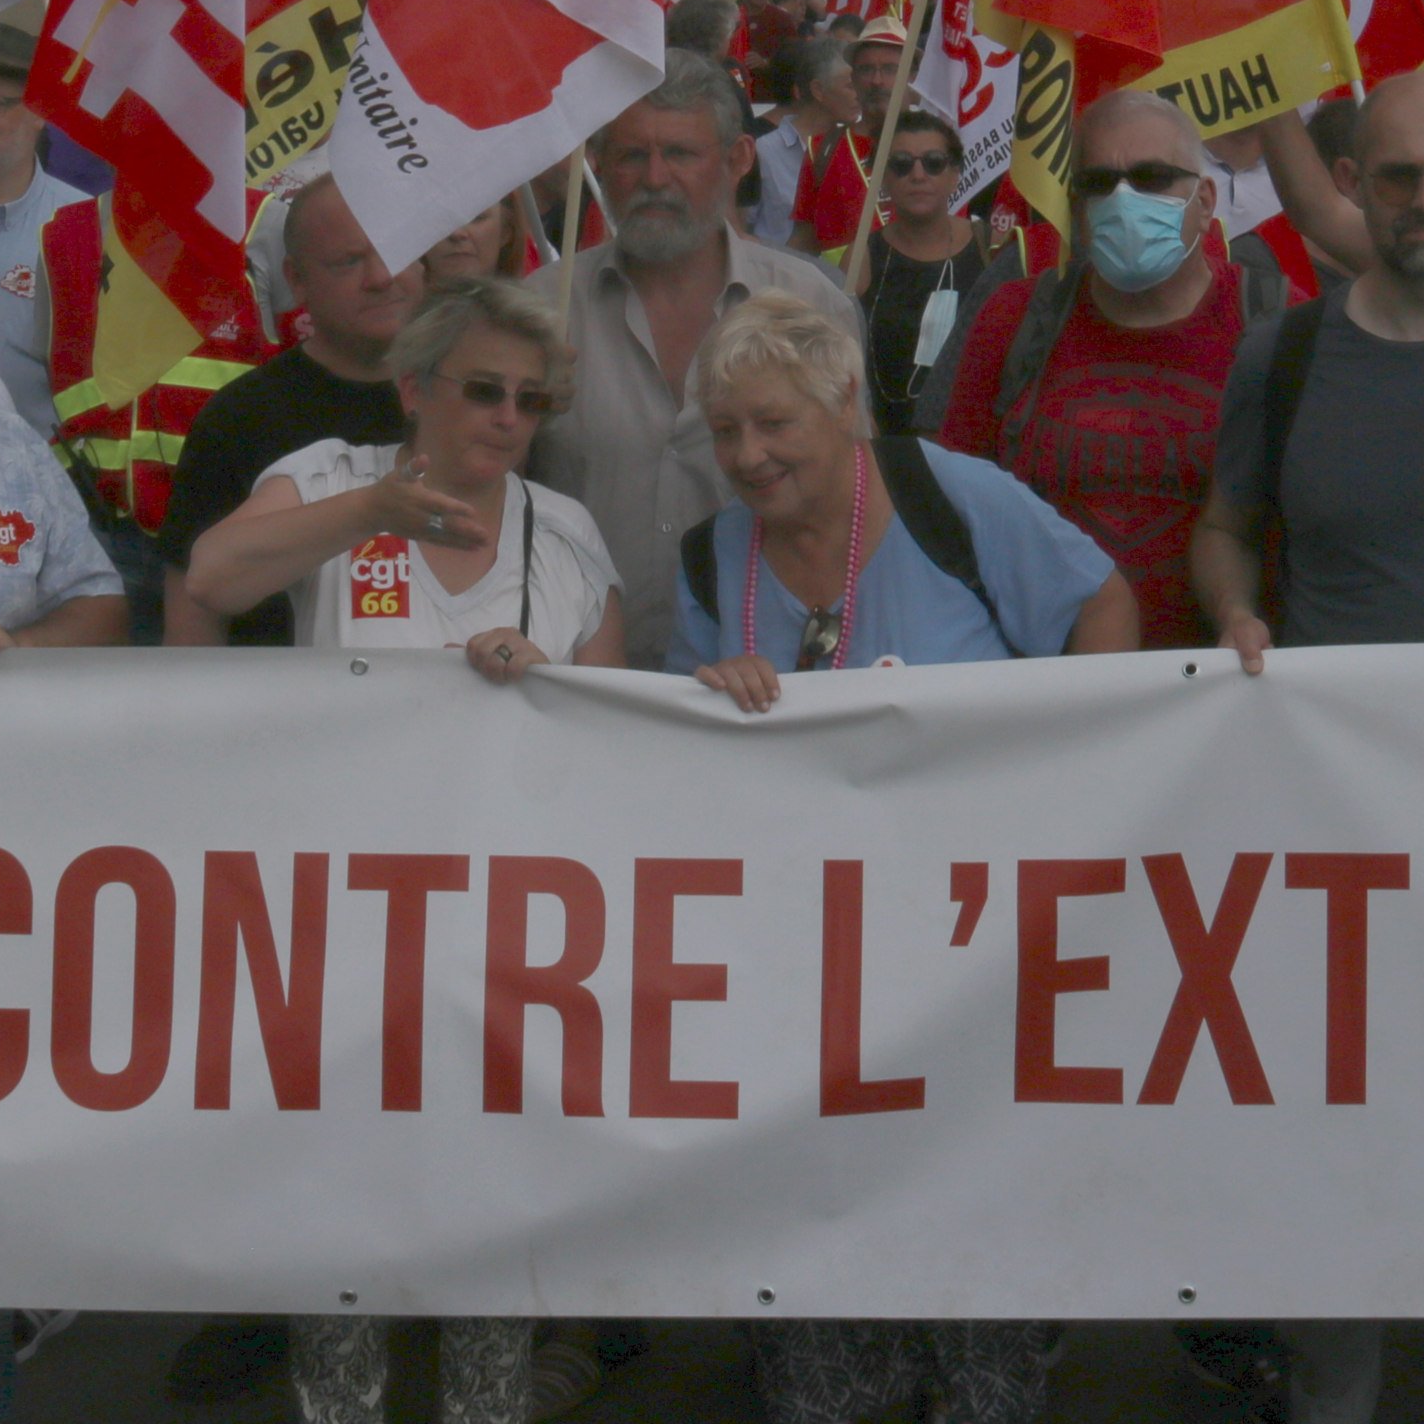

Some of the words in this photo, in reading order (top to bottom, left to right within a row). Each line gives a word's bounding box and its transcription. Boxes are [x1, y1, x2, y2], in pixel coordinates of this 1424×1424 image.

[349, 37, 429, 174] nitaire
[350, 552, 412, 589] cgt
[360, 591, 399, 615] 66
